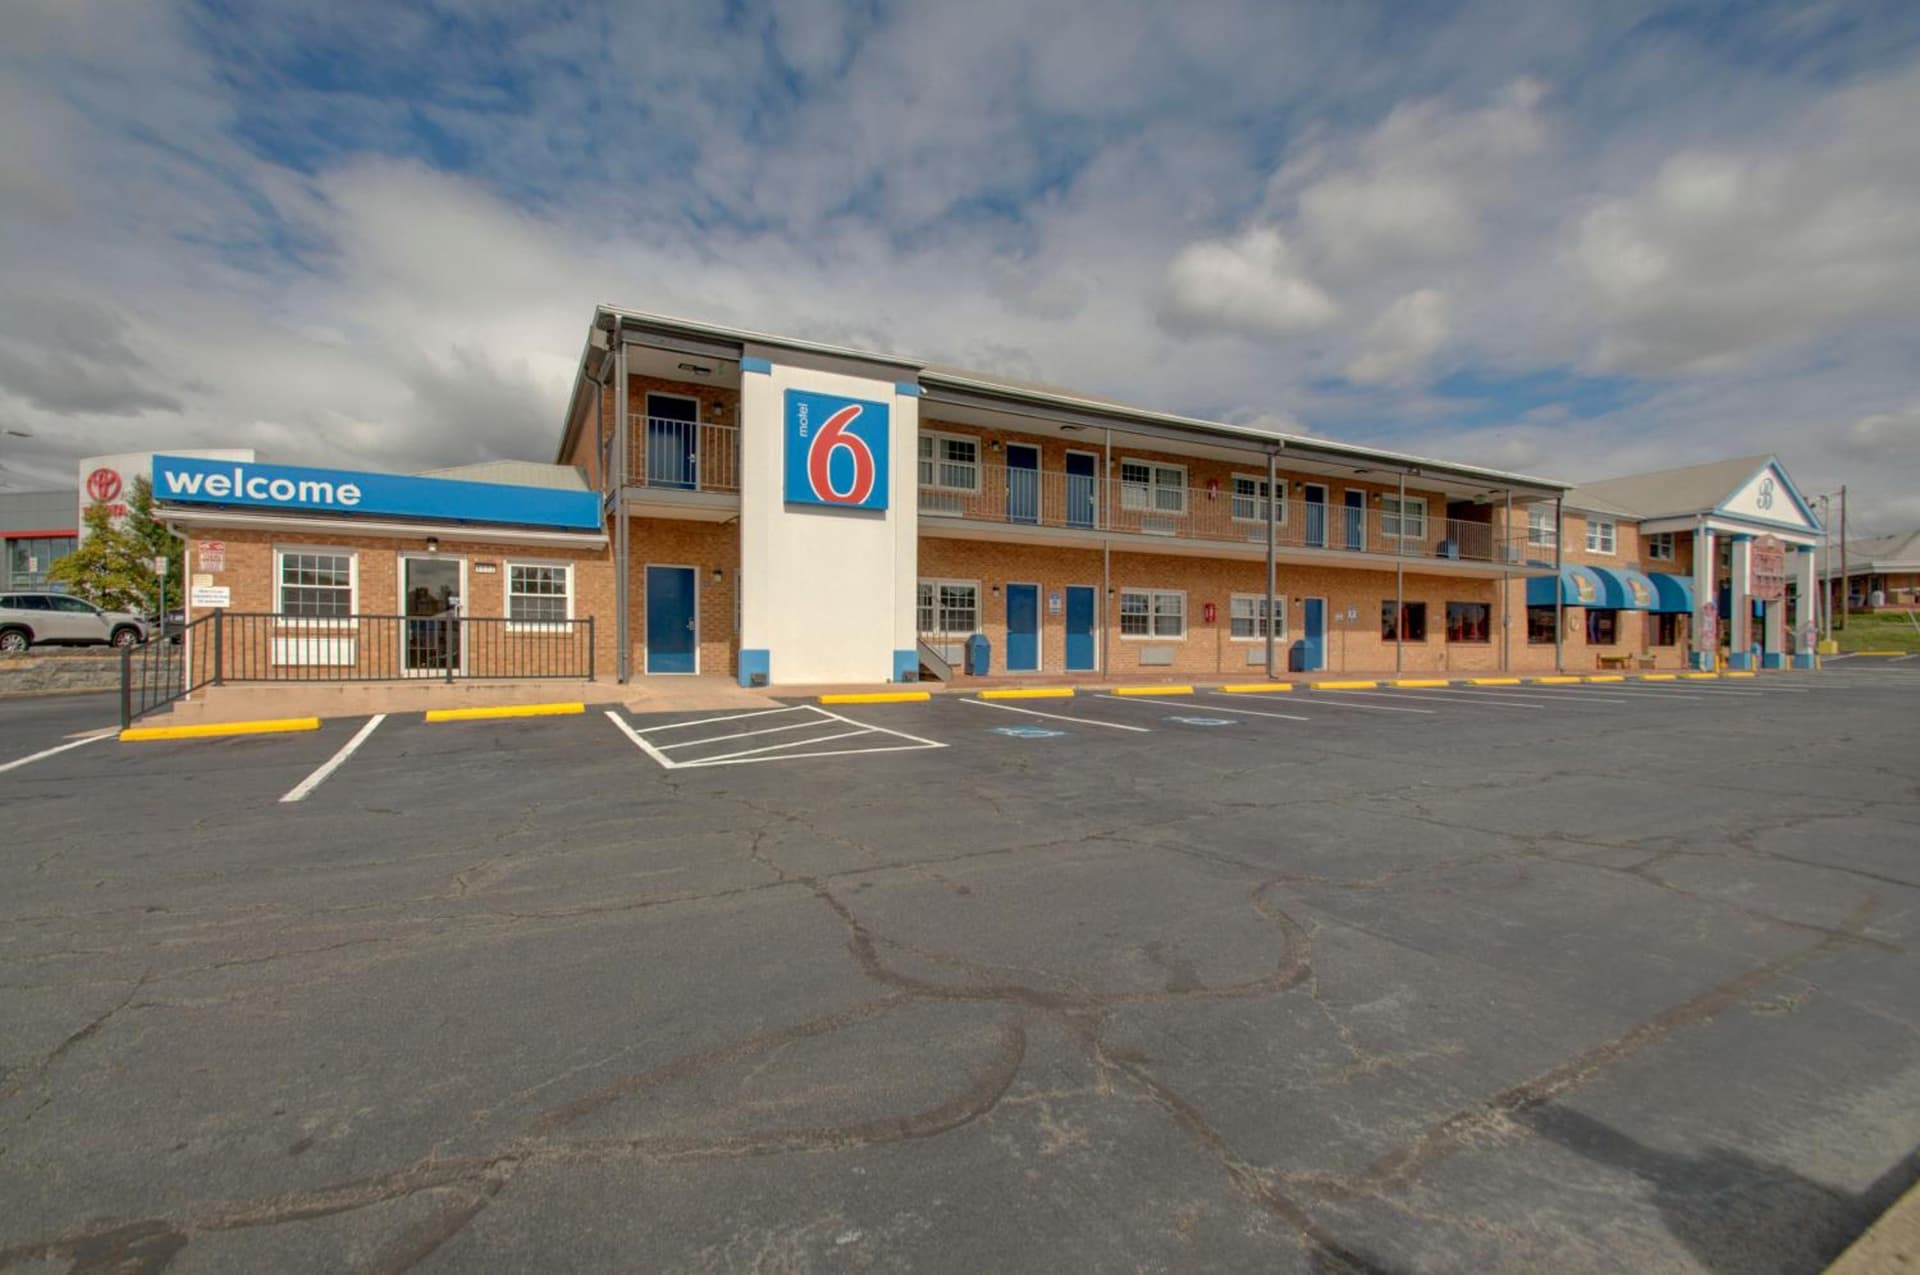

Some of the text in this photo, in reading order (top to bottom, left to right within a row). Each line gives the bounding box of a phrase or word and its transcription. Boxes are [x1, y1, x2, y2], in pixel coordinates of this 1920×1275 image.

[797, 402, 808, 437] motel
[807, 404, 875, 504] 6
[164, 467, 362, 506] welcome
